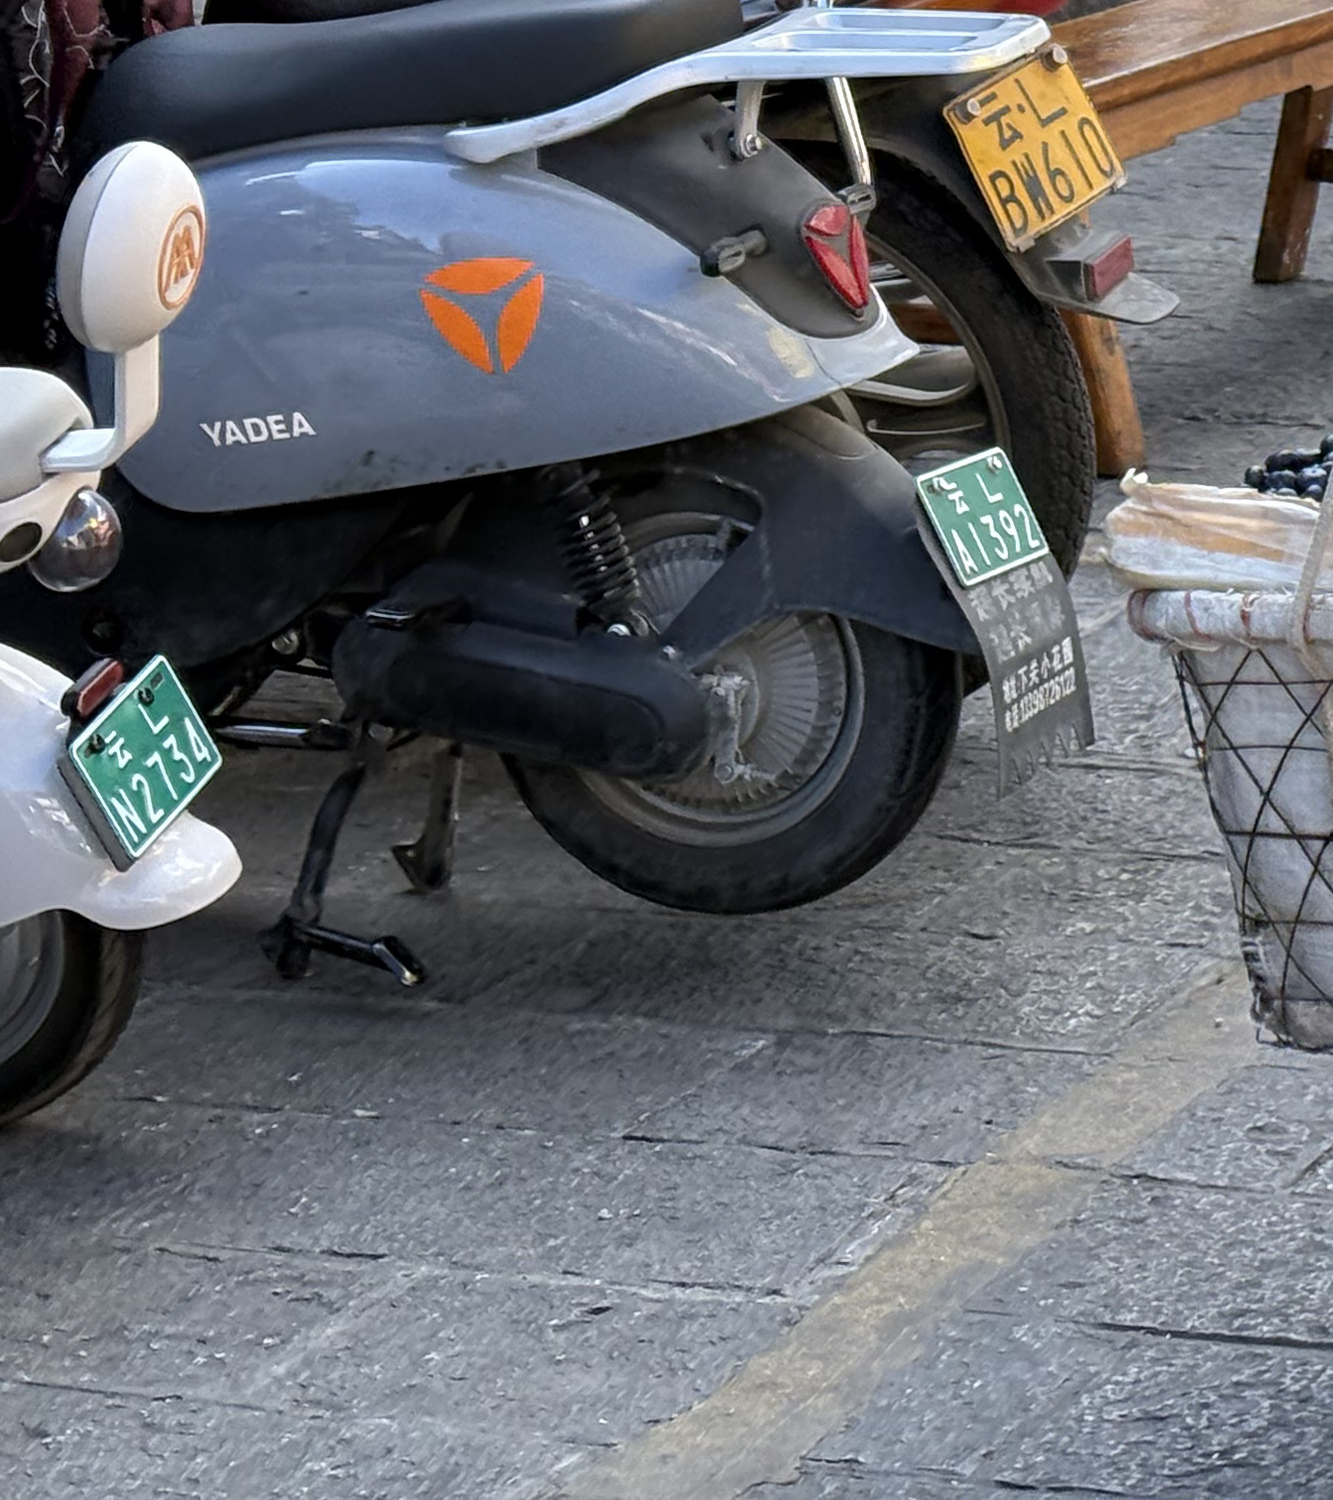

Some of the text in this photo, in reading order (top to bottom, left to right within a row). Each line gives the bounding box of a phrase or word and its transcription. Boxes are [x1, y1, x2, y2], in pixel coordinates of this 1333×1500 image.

[988, 116, 1116, 237] BW610
[199, 411, 318, 447] YADEA
[950, 503, 1042, 576] A1392
[110, 716, 213, 844] N2734
